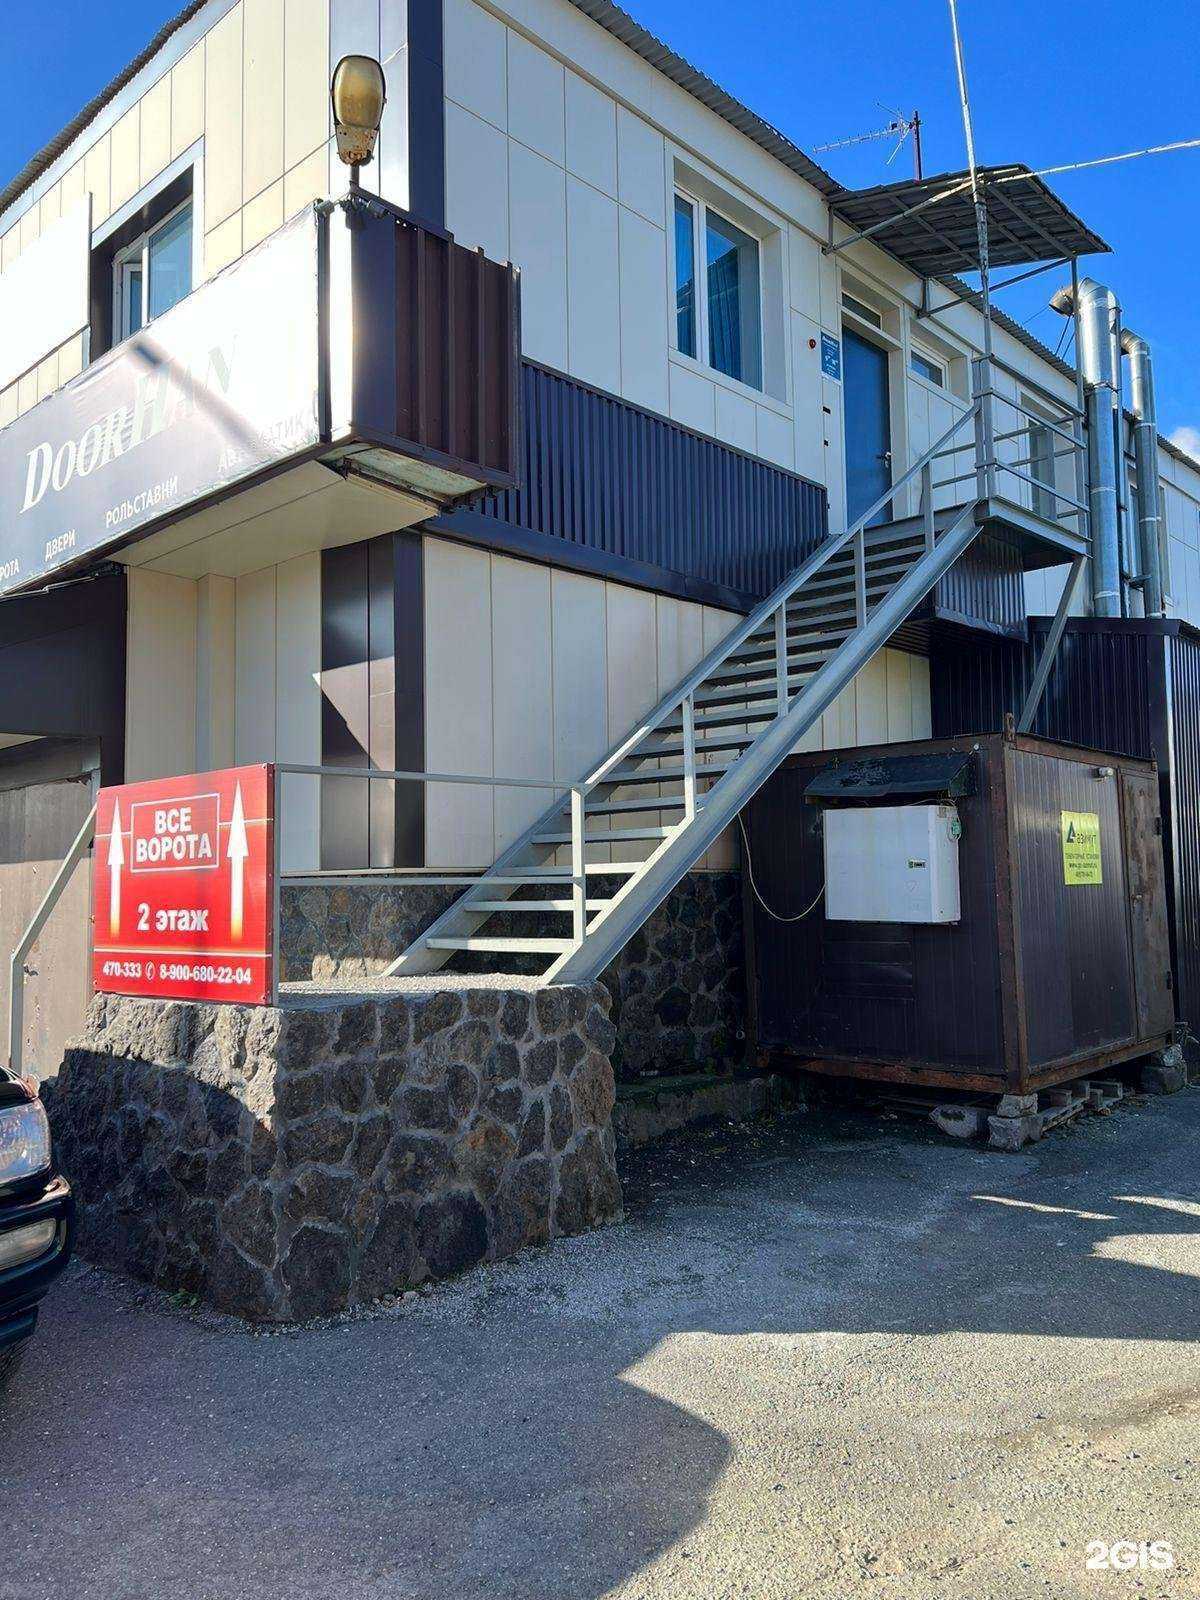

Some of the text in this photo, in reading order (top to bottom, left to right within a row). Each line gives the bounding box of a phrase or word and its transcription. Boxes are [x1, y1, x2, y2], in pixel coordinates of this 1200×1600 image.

[45, 529, 76, 562] ДВЕРИ
[105, 475, 178, 528] РОЛЬСТАВНИ
[154, 807, 192, 834] ВСЕ
[136, 833, 212, 862] ВОРОТА
[137, 903, 209, 931] 2 этаж
[103, 961, 251, 983] 470-333 8-900-680-22-04
